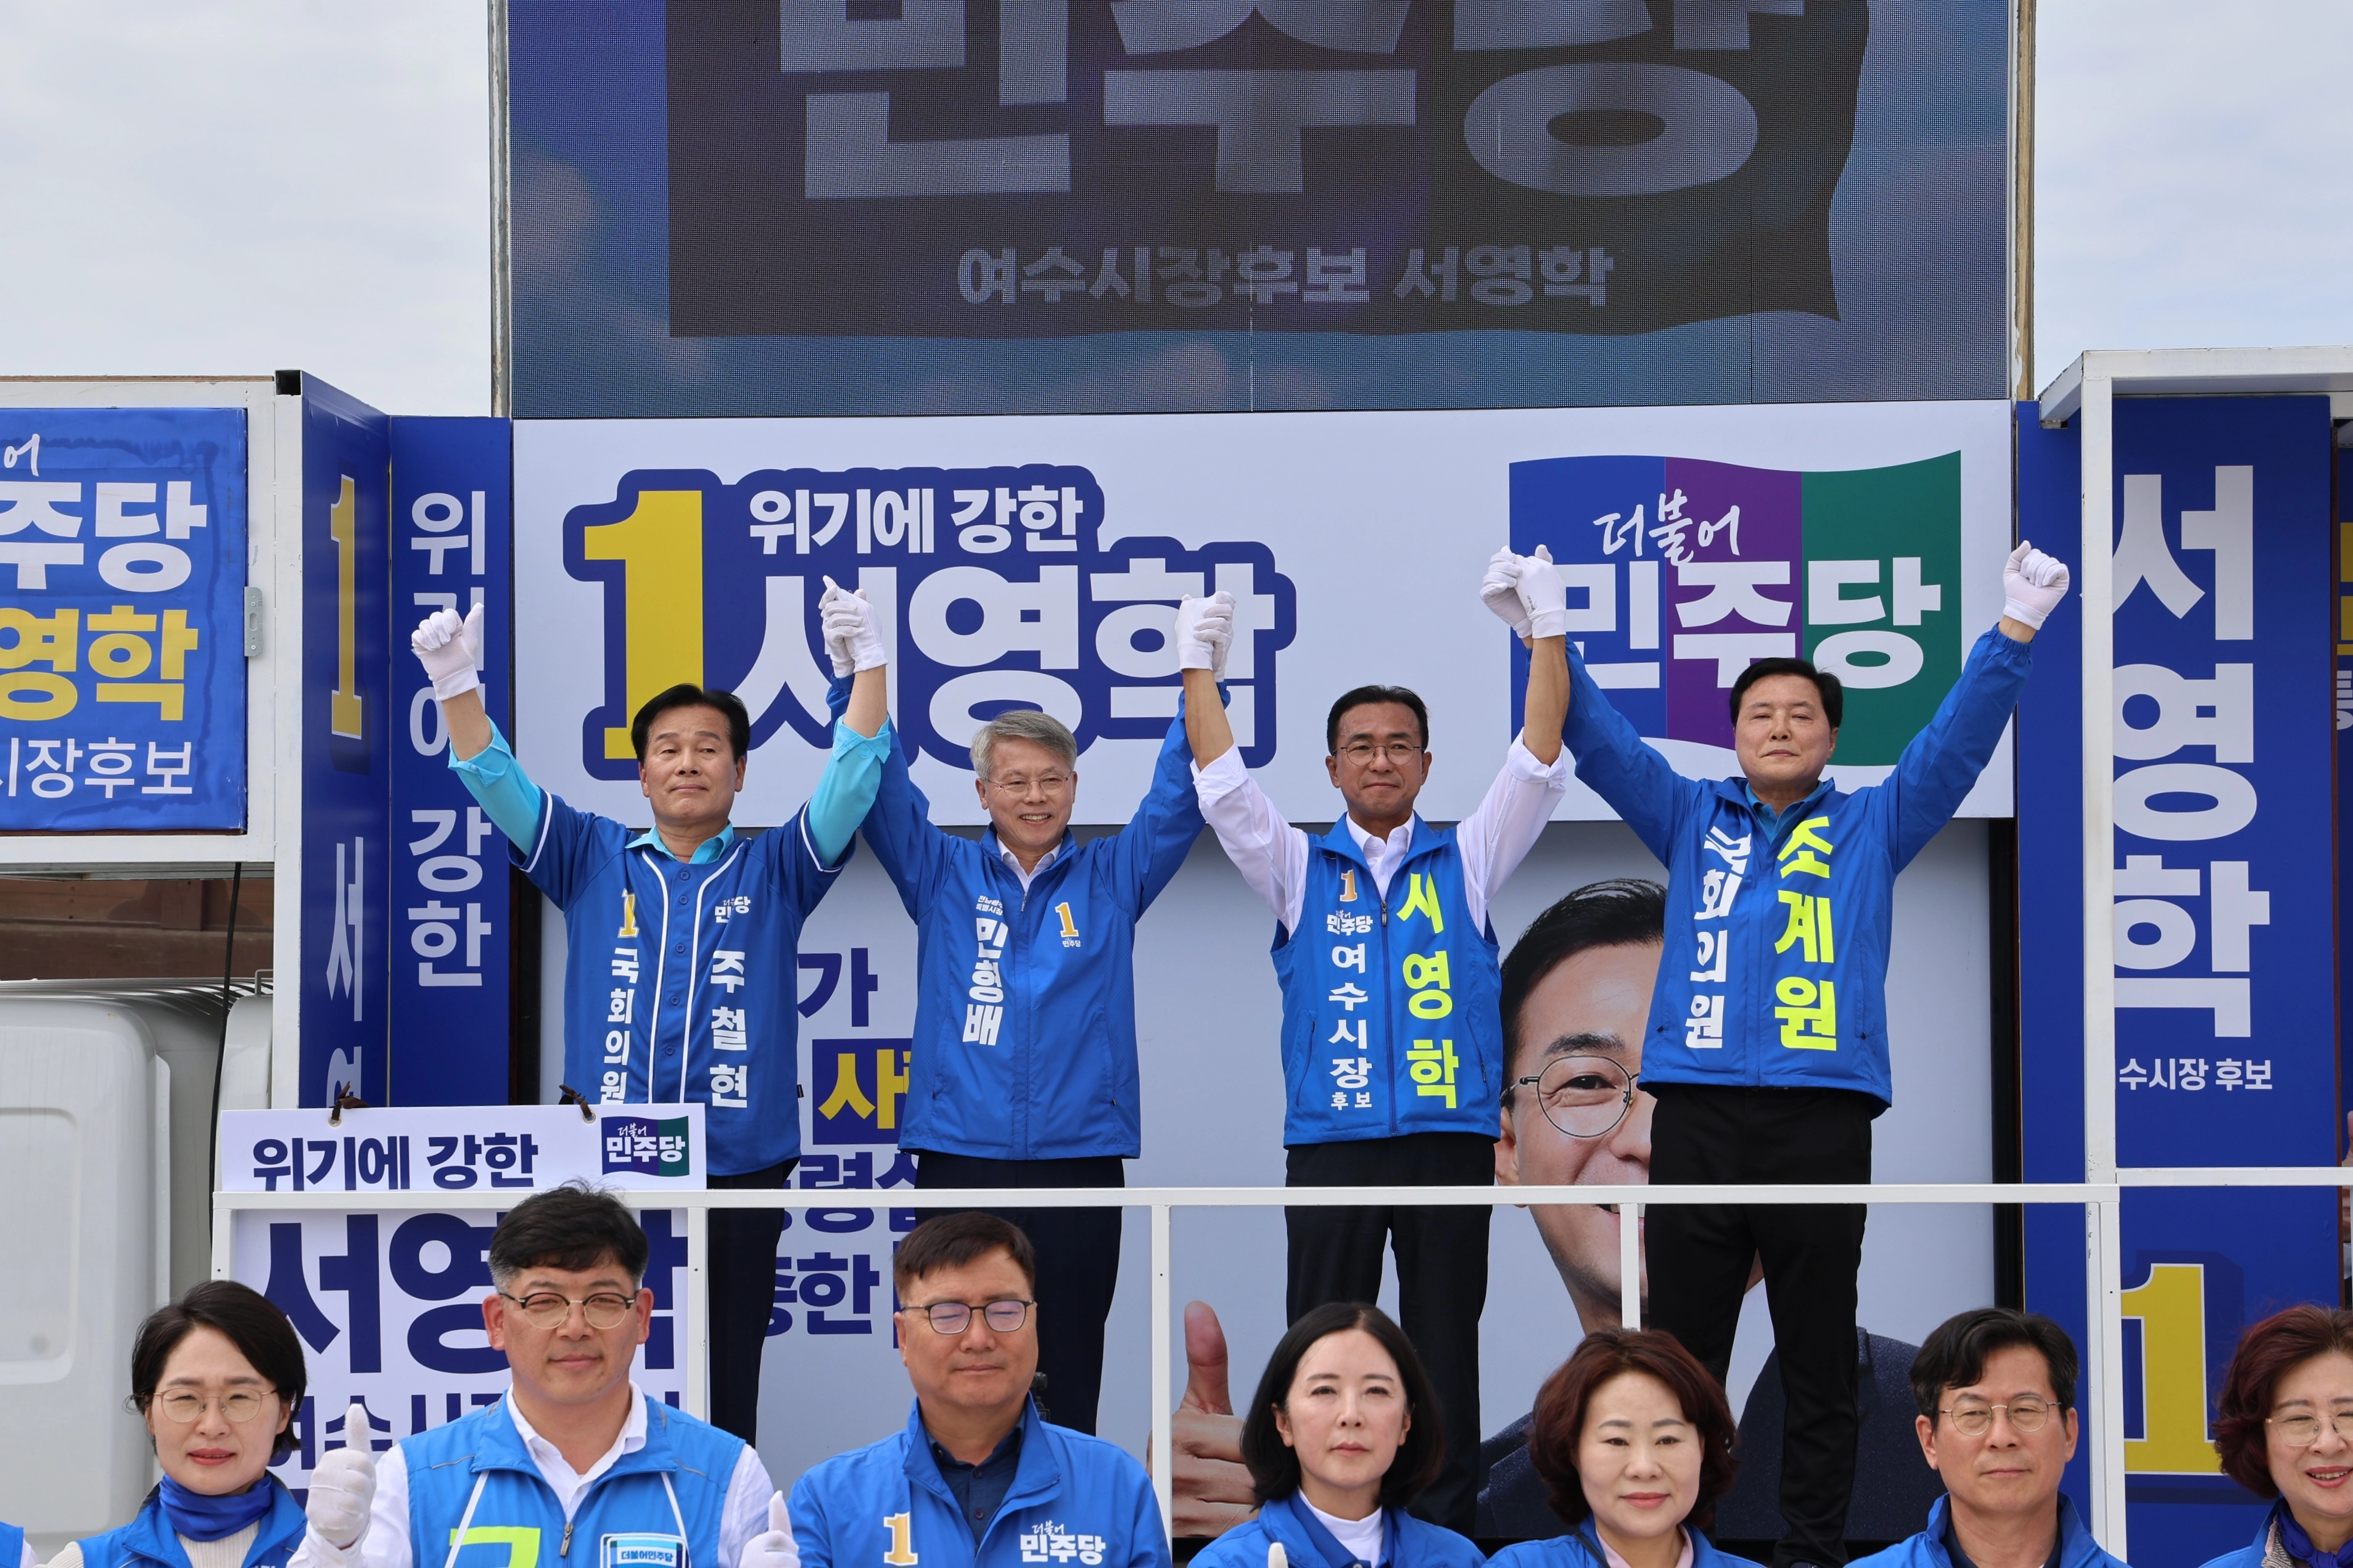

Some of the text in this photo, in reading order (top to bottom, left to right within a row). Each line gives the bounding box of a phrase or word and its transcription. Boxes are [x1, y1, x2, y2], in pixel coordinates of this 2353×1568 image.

[957, 245, 1614, 307] 여수시장후보 서영학
[750, 485, 1083, 554] 위기에 강한
[1593, 489, 1741, 566] 더불어
[331, 475, 362, 739] 1
[585, 490, 704, 760] 1
[1560, 557, 1942, 689] 민주당
[731, 558, 1275, 748] 서영학
[407, 807, 492, 987] 강한
[1340, 869, 1358, 901] 1
[1055, 902, 1079, 938] 1
[1327, 914, 1374, 936] 민주당
[1685, 826, 1752, 1049] 국회의원
[1774, 816, 1837, 1051] 조계원
[962, 917, 1009, 1046] 민형배
[1328, 943, 1373, 1089] 여수시장
[600, 947, 640, 1105] 국회의원
[711, 950, 748, 1108] 주철현
[1331, 1092, 1372, 1110] 후보
[2215, 1059, 2273, 1091] 후보
[253, 1132, 539, 1191] 위기에 강한
[606, 1136, 686, 1163] 민주당
[617, 1122, 647, 1138] 더불어
[2120, 1263, 2227, 1476] 1
[621, 1550, 674, 1563] 더불어민주당
[883, 1511, 918, 1566] 1
[1020, 1534, 1106, 1566] 민주당
[1032, 1519, 1065, 1537] 더불어
